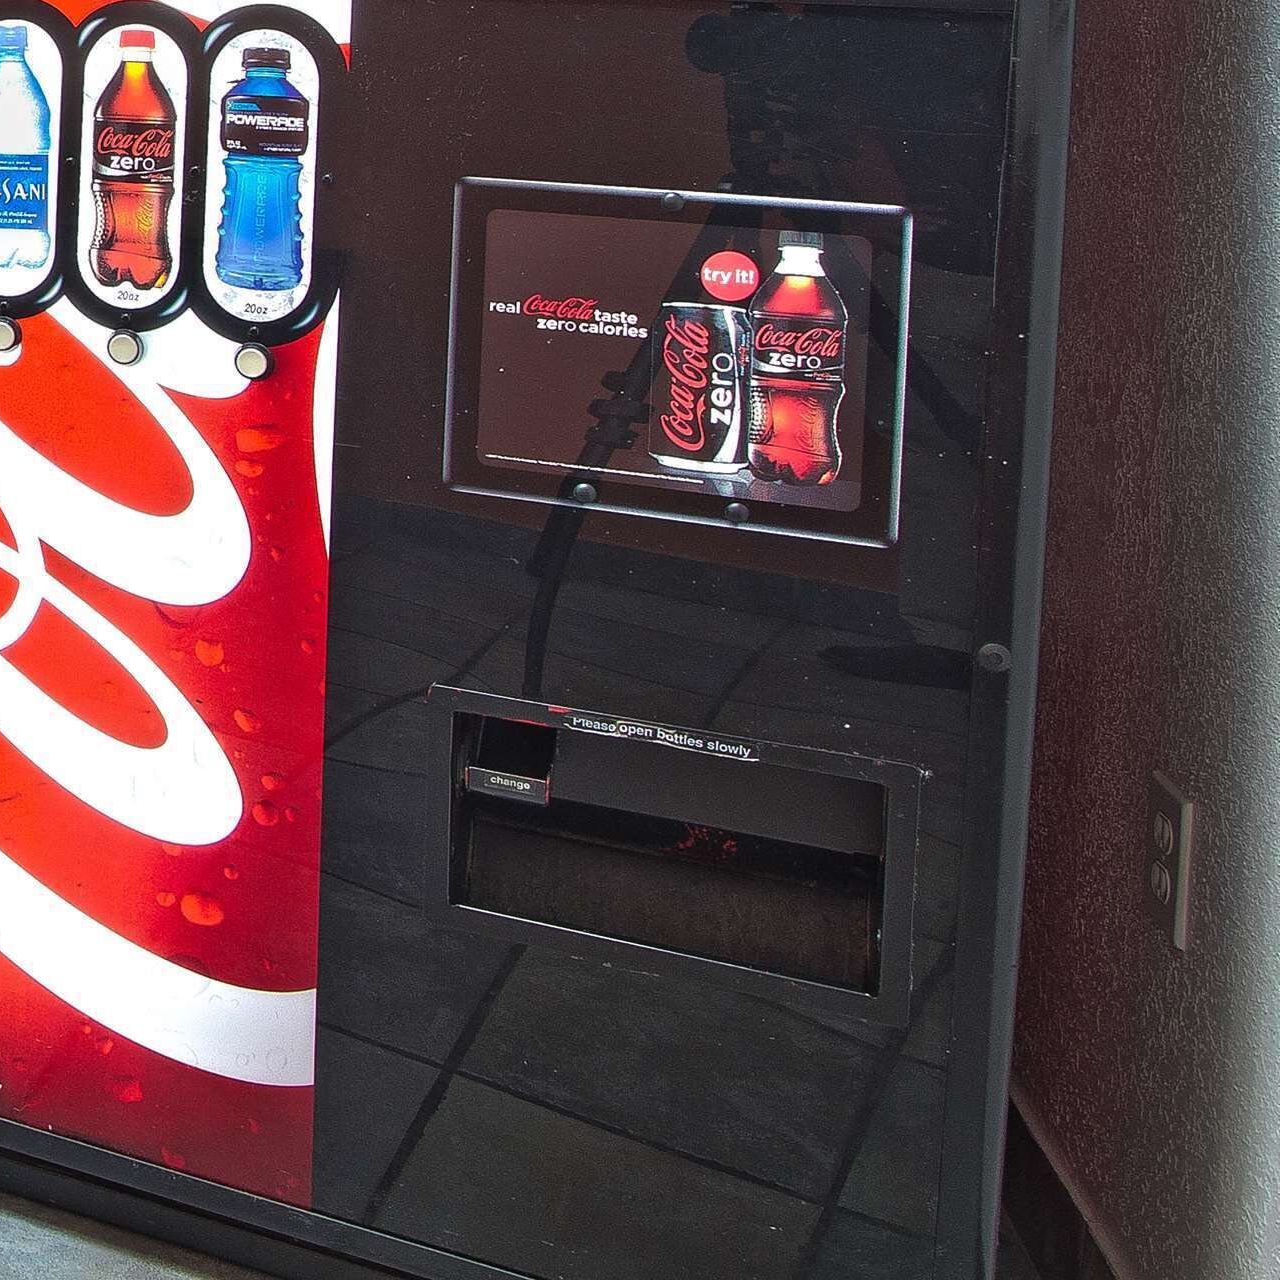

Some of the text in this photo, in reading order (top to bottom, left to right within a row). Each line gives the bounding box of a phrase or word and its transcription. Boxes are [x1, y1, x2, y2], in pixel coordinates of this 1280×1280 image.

[226, 113, 305, 128] POWERADE
[97, 126, 173, 157] Coca-Cola
[110, 156, 155, 170] zero
[703, 267, 755, 286] try it!
[244, 304, 268, 314] 20oz
[489, 294, 638, 325] real Coca-Cola taste
[536, 318, 648, 339] zero calories
[755, 323, 842, 358] Coca-Cola
[769, 351, 822, 370] zero
[660, 313, 711, 452] Coca-Cola
[710, 351, 734, 427] zero
[618, 721, 752, 760] open bottles slowly
[490, 773, 531, 791] change
